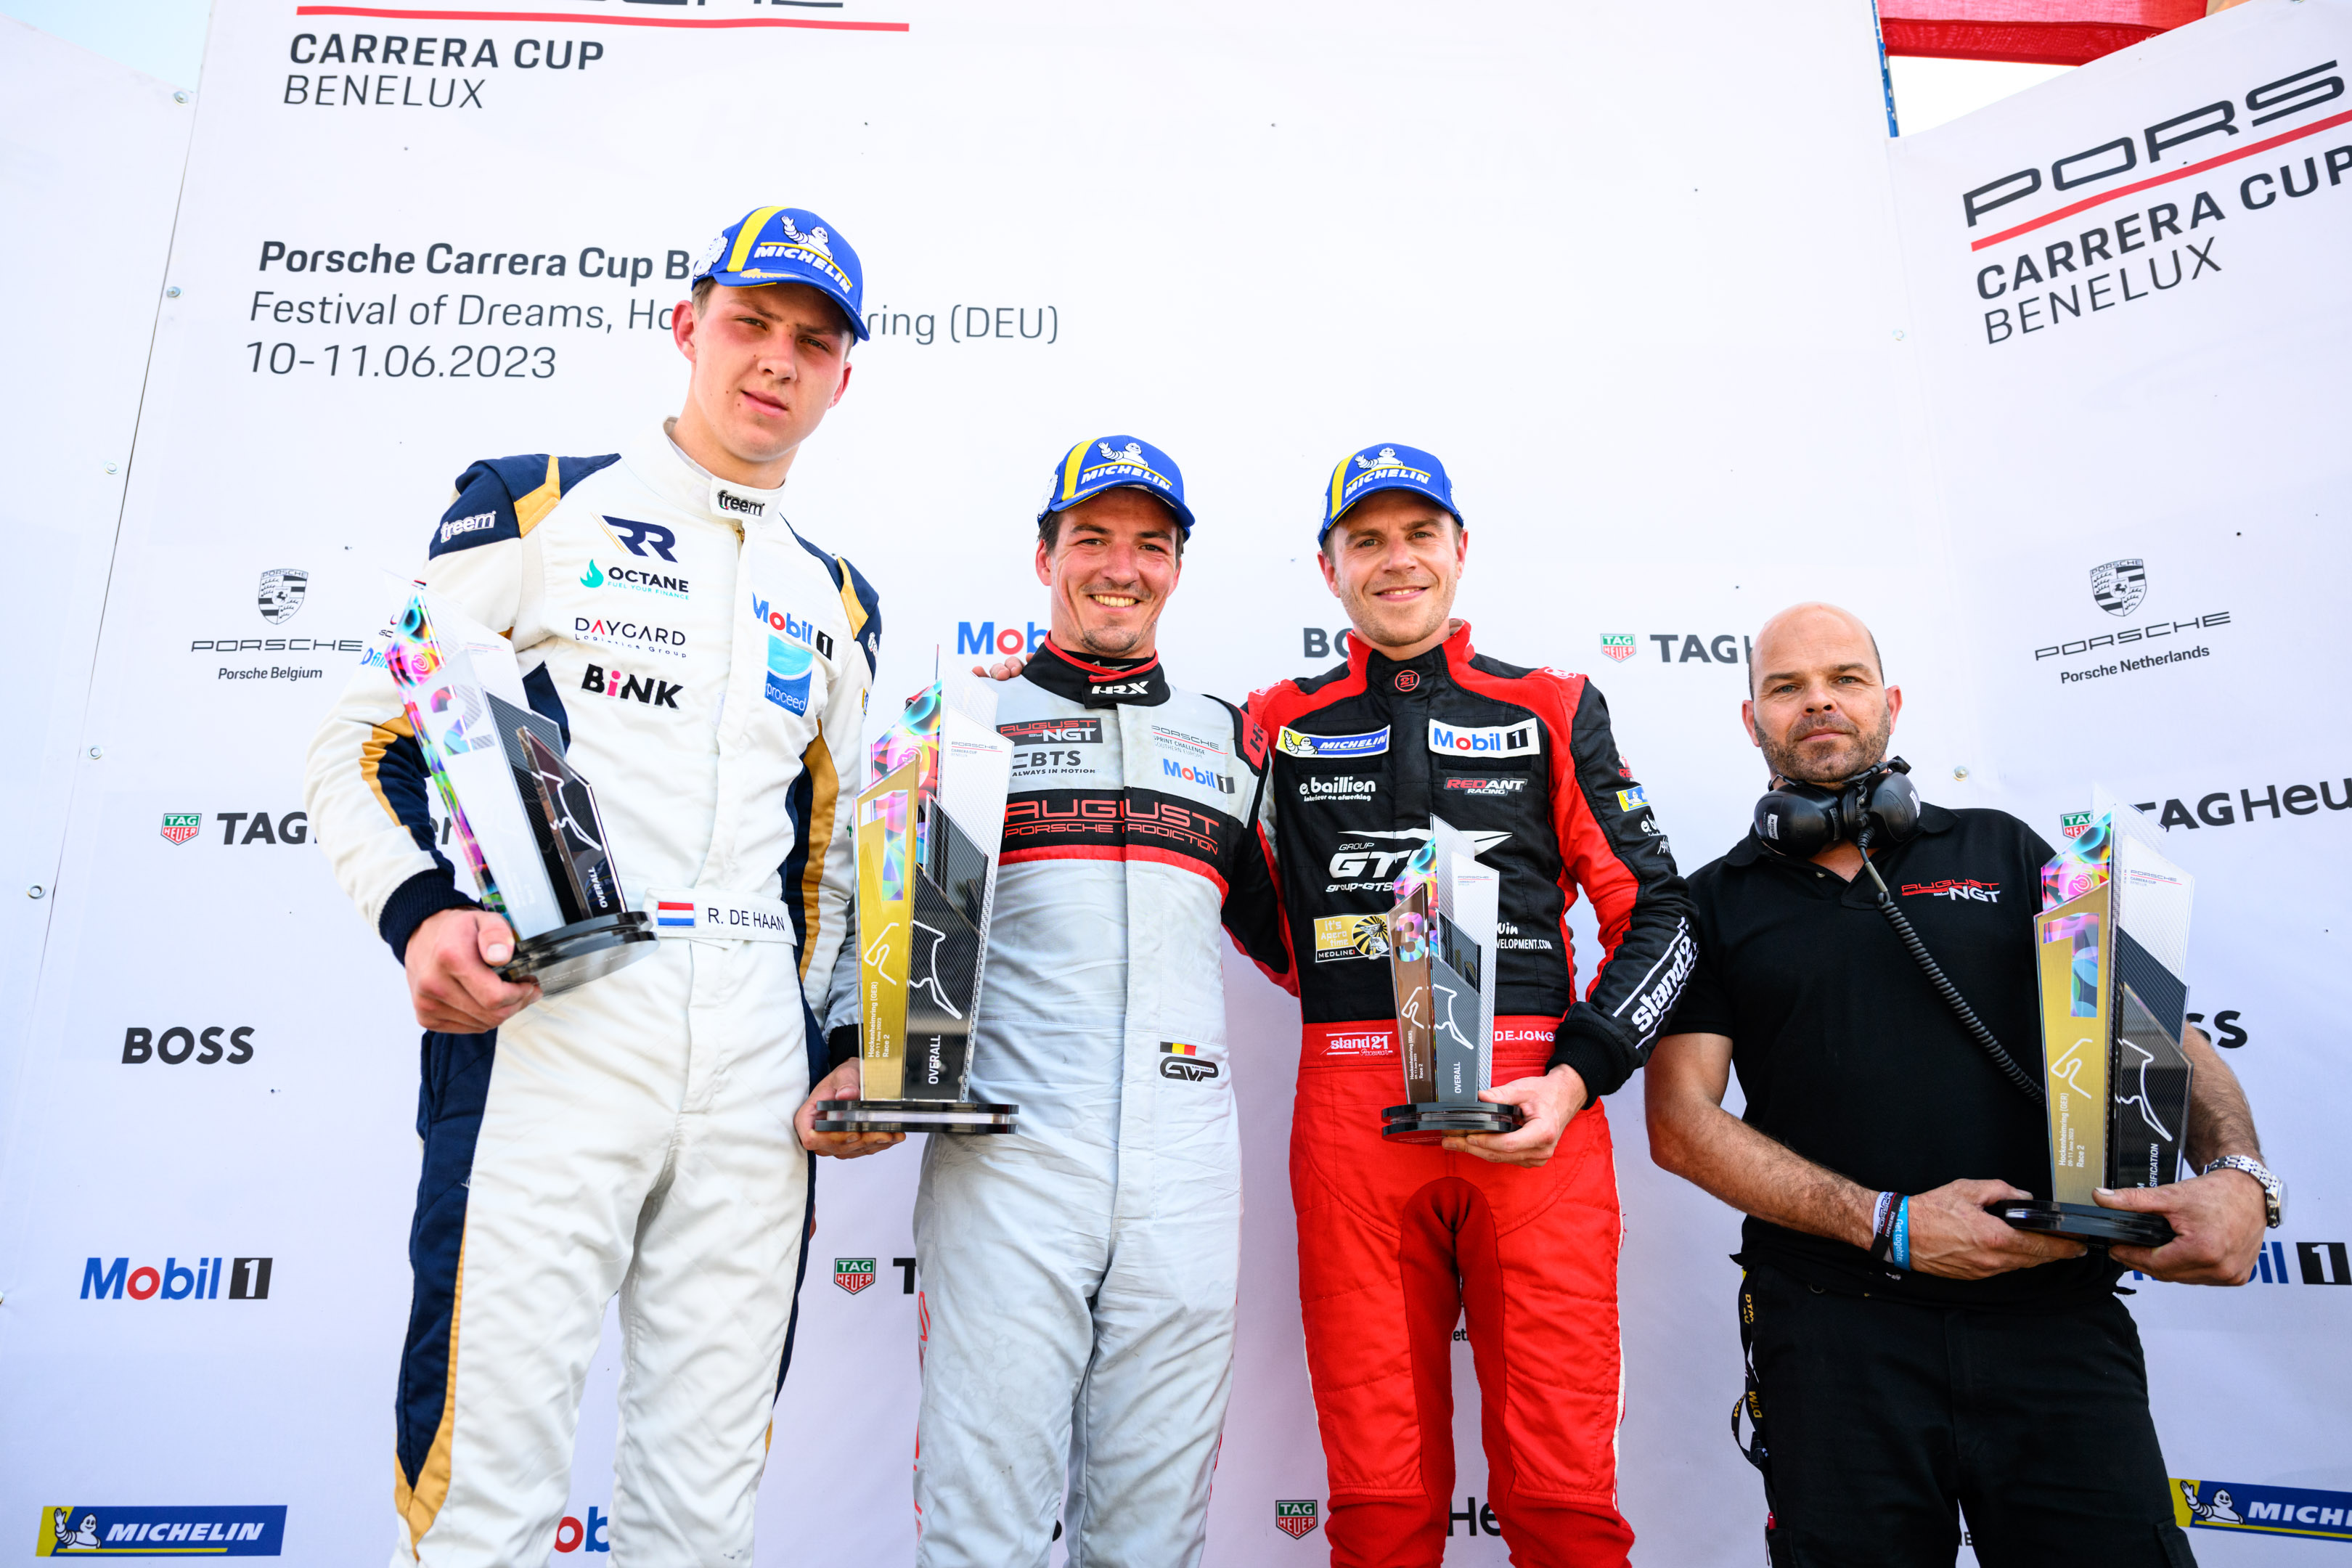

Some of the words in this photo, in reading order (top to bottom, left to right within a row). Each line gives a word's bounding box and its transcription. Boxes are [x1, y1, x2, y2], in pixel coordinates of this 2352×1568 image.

[290, 33, 499, 68] CARRERA
[513, 38, 605, 70] CUP
[283, 75, 486, 109] BENELUX
[1976, 191, 2226, 300] CARRERA
[2239, 144, 2352, 211] CUP
[259, 241, 415, 274] Porsche
[426, 244, 566, 277] Carrera
[579, 248, 653, 286] Cup
[754, 246, 852, 294] MICHELIN
[1985, 236, 2222, 345] BENELUX
[249, 291, 396, 325] Festival
[409, 293, 449, 325] of
[458, 296, 612, 333] Dreams,
[950, 305, 1058, 345] (DEU)
[247, 341, 556, 379] 10-11.06.2023
[1081, 464, 1171, 491] MICHELIN
[1344, 469, 1430, 499] MICHELIN
[717, 490, 764, 517] freem
[441, 512, 495, 543] freem
[262, 569, 306, 578] PORSCHE
[608, 567, 689, 592] OCTANE
[2091, 560, 2141, 575] PORSCHE
[656, 589, 689, 600] FINANCE
[575, 618, 685, 646] DAYGARD
[752, 592, 813, 645] Mobil
[191, 639, 363, 652] PORSCHE
[957, 622, 1047, 655] Mob
[1650, 634, 1738, 663] TAG
[2035, 611, 2231, 661] PORSCHE
[649, 646, 687, 658] Group
[1604, 646, 1633, 660] HEUER
[2060, 665, 2118, 684] Porsche
[2120, 645, 2210, 672] Netherlands
[218, 667, 268, 679] Porsche
[271, 666, 322, 682] Belgium
[1400, 676, 1413, 685] 21
[767, 683, 807, 711] proceed
[1092, 681, 1149, 695] HRX
[430, 684, 495, 757] 2
[1000, 720, 1096, 734] AUGUST
[952, 741, 997, 750] PORSCHE
[1043, 727, 1096, 742] NGT
[1151, 725, 1219, 751] PORSCHE
[1175, 740, 1205, 755] CHALLENGE
[1320, 735, 1387, 749] MICHELIN
[1434, 727, 1500, 751] Mobil
[1163, 758, 1216, 788] Mobil
[167, 816, 197, 825] TAG
[217, 812, 308, 845] TAG
[1005, 799, 1219, 835] AUGUST
[163, 827, 196, 841] HEUER
[1005, 823, 1114, 838] PORSCHE
[1127, 823, 1218, 855] ADDICTION
[1339, 842, 1375, 851] GROUP
[588, 866, 608, 908] OVERALL
[1901, 879, 1999, 892] AUGUST
[2131, 870, 2176, 882] PORSCHE
[1948, 886, 2000, 902] NGT
[709, 907, 723, 924] R.
[730, 910, 750, 926] DE
[753, 912, 785, 931] HAAN
[1324, 920, 1342, 931] it's
[1395, 912, 1425, 962] 3
[1497, 939, 1552, 950] VELOPMENT.COM
[2043, 912, 2099, 1018] 1
[868, 1002, 878, 1058] Hockenheimring
[122, 1026, 255, 1065] BOSS
[928, 1034, 941, 1085] OVERALL
[1453, 1061, 1462, 1093] OVERALL
[2060, 1093, 2069, 1111] (GER)
[2059, 1112, 2069, 1166] Hockenheimring
[2076, 1151, 2085, 1168] Race
[2149, 1143, 2159, 1187] SIFICATION
[79, 1257, 222, 1300] Mobil
[839, 1262, 872, 1271] TAG
[837, 1275, 873, 1291] HEUER
[1745, 1294, 1754, 1323] DTM
[1748, 1391, 1763, 1418] DTM
[1281, 1503, 1312, 1515] TAG
[106, 1522, 264, 1542] MICHELIN
[1279, 1518, 1315, 1534] HEUER
